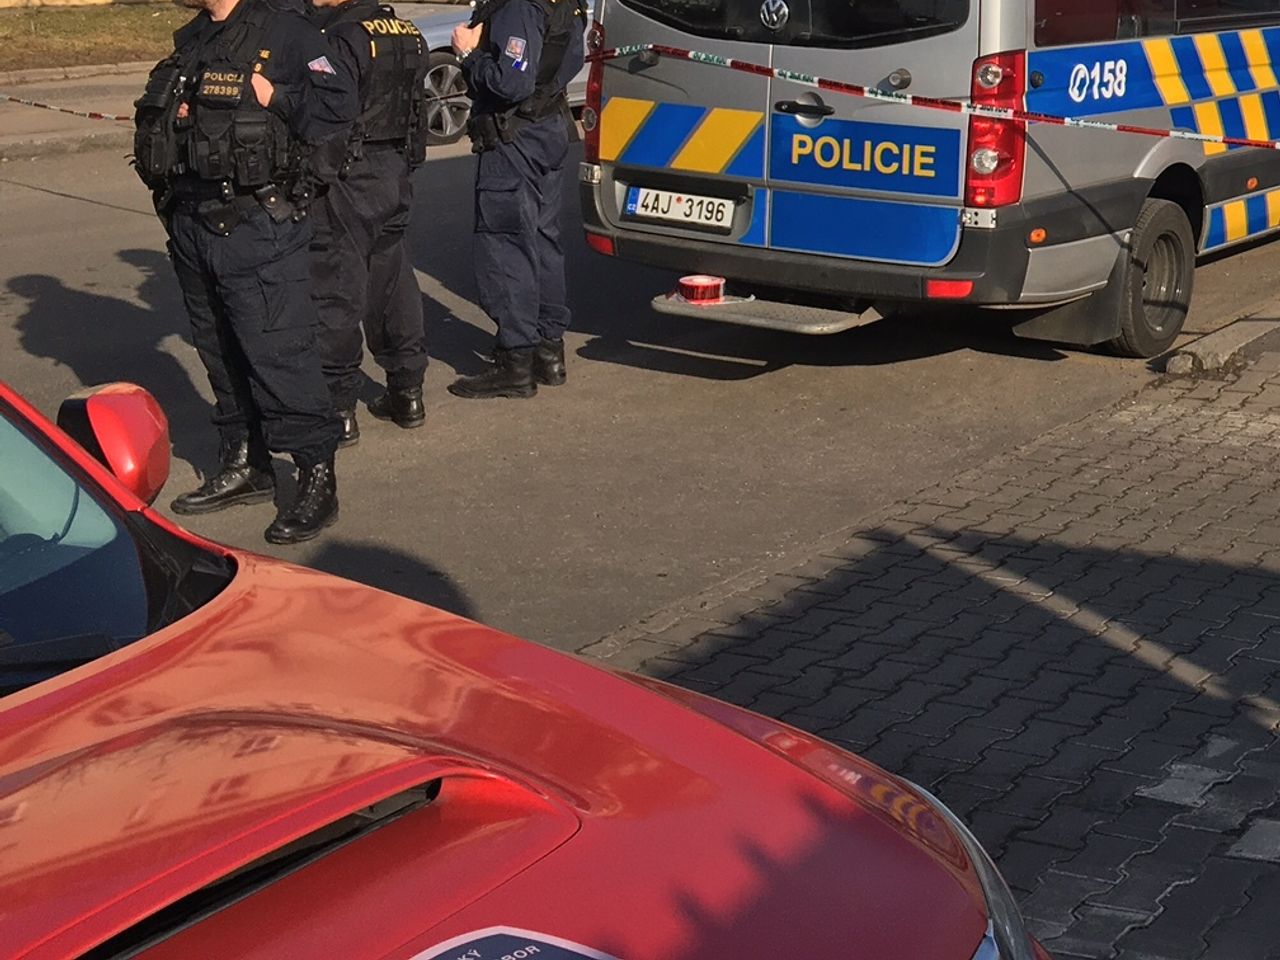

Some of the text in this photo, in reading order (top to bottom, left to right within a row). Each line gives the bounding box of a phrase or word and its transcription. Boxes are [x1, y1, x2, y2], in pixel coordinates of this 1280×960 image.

[362, 18, 421, 35] POLICIE
[1090, 59, 1128, 100] 158
[791, 133, 936, 178] POLICIE
[641, 191, 673, 215] 4AJ
[683, 197, 727, 222] 3196
